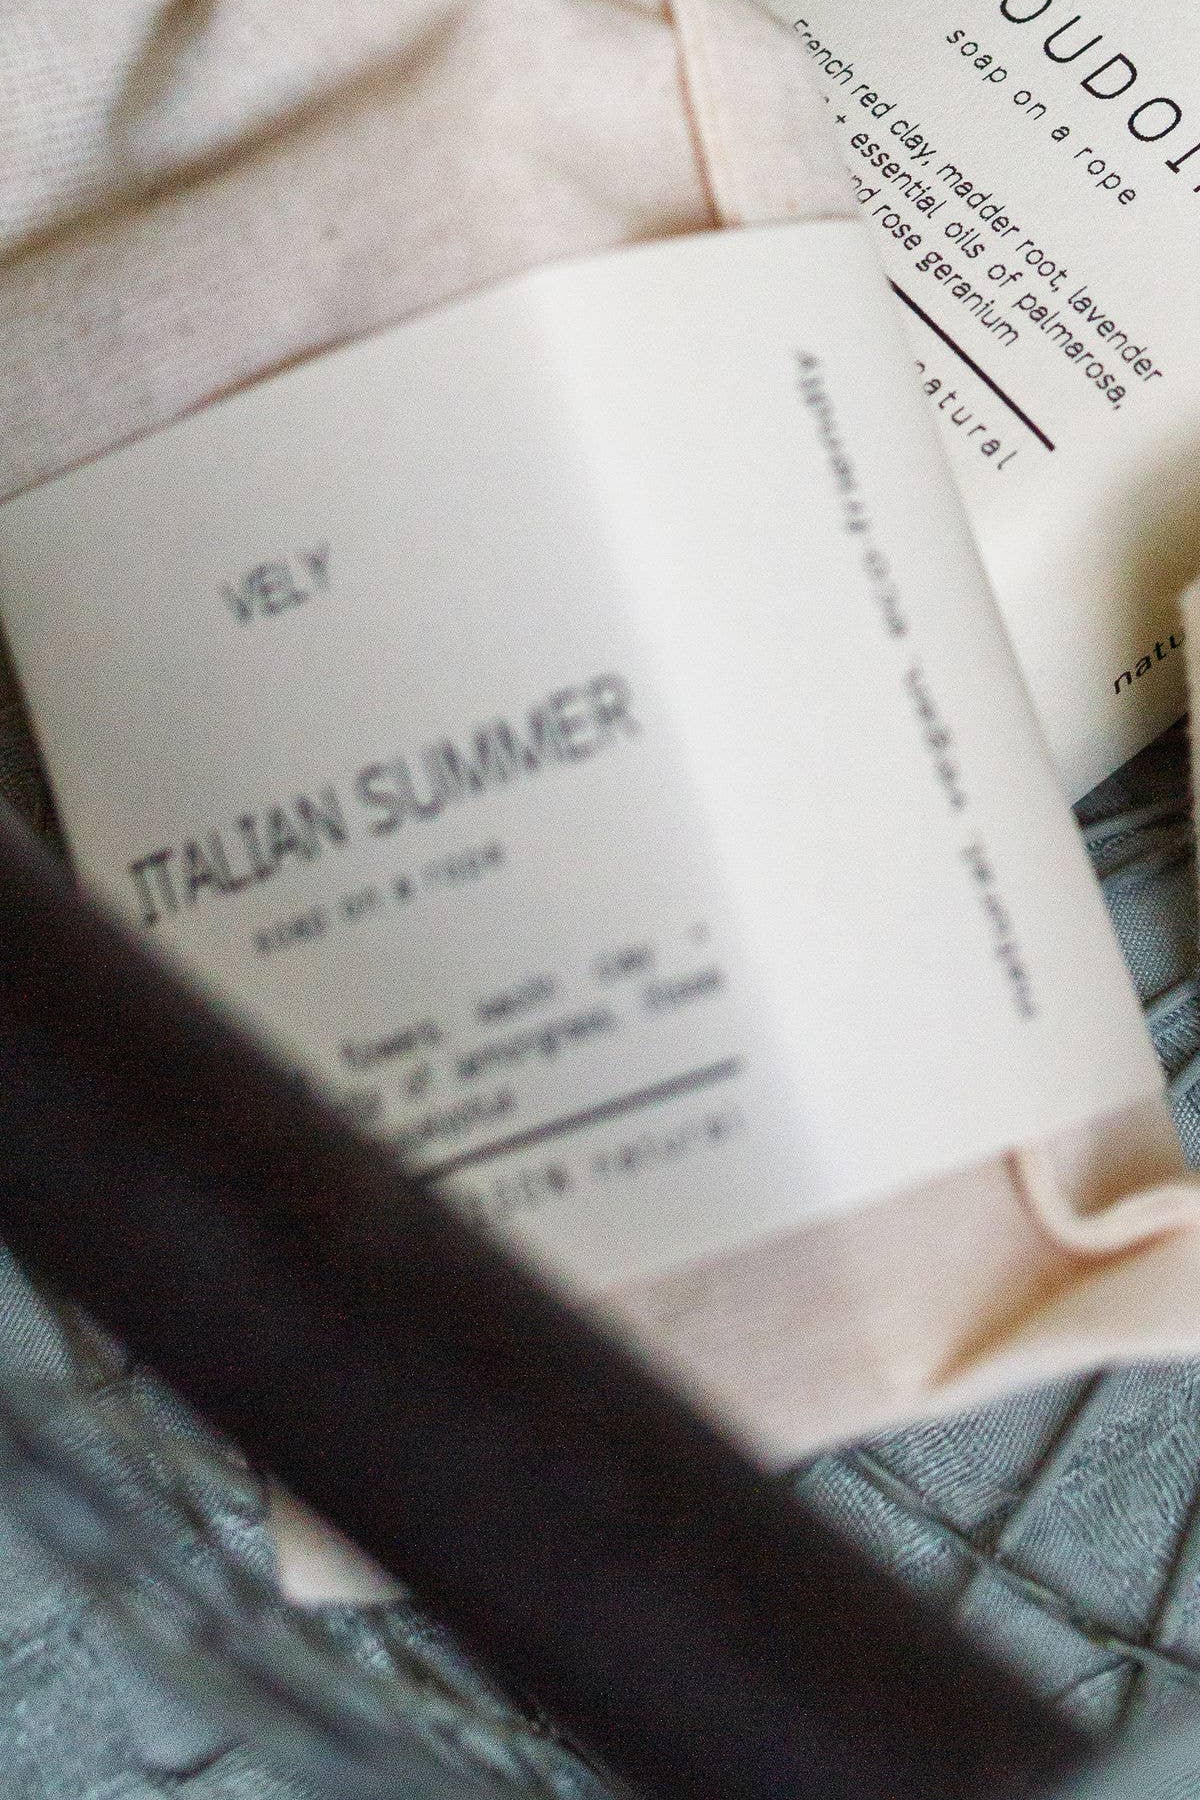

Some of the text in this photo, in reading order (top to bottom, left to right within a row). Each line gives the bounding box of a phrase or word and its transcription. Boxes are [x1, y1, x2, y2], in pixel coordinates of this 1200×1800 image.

[946, 28, 1138, 207] soap on a rope
[850, 83, 898, 119] red
[889, 118, 932, 167] clay,
[936, 159, 1019, 240] madder
[1015, 237, 1068, 294] root,
[1067, 284, 1164, 385] lavender
[850, 131, 941, 221] essential
[944, 219, 987, 261] oils
[986, 259, 1024, 290] of
[1013, 289, 1125, 413] palmarosa,
[851, 173, 1020, 349] nd rose geranium
[217, 542, 332, 625] VELY
[131, 672, 641, 930] ITALIAN SUMMER
